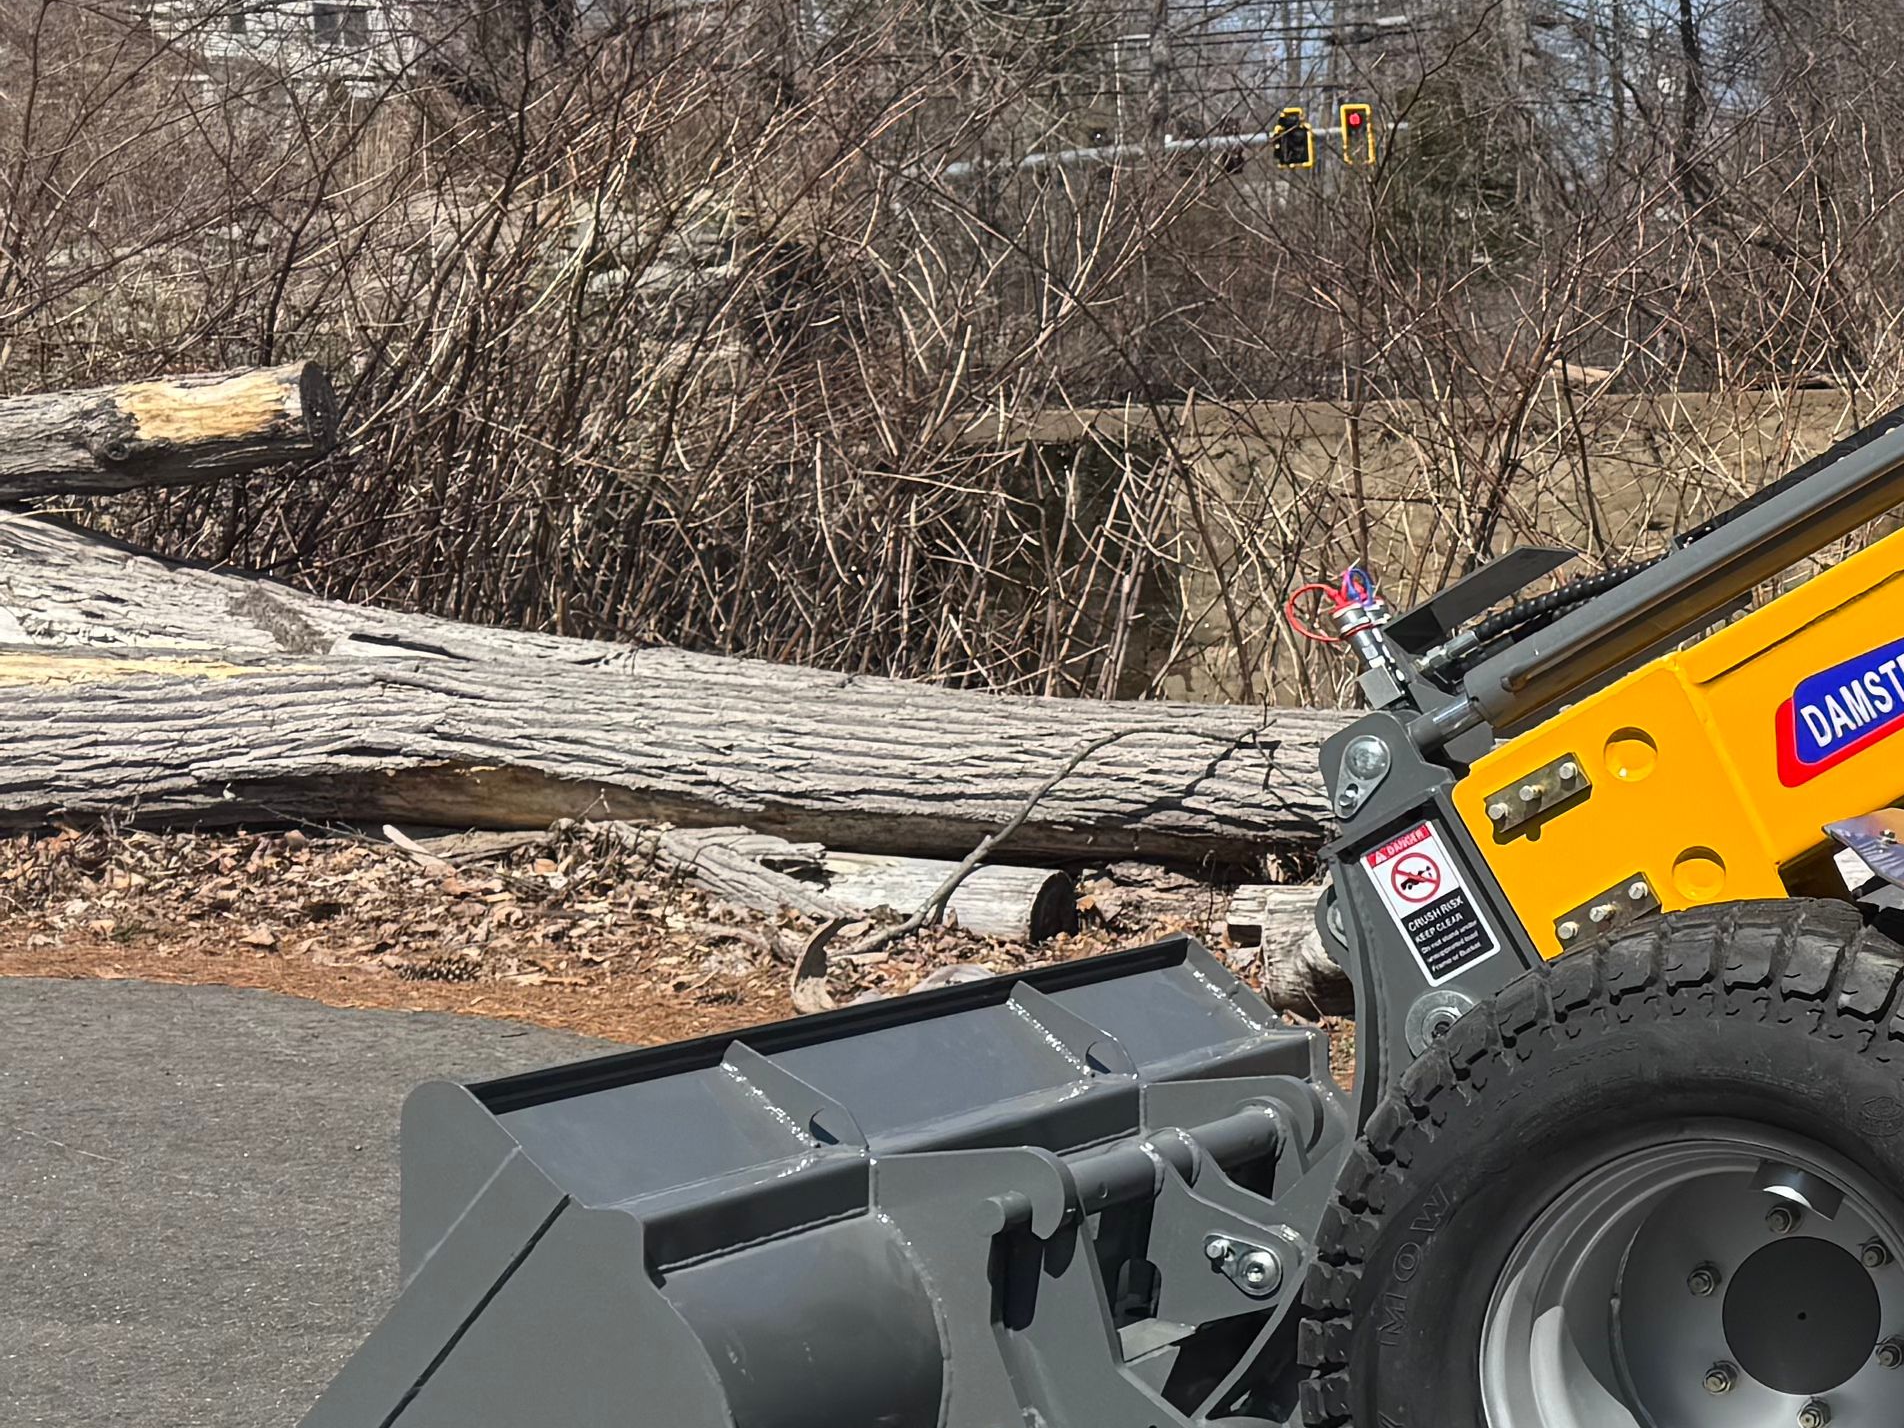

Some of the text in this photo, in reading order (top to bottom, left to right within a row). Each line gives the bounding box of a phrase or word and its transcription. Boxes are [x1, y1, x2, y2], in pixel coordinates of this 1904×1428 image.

[1386, 829, 1425, 856] DANGER
[1408, 895, 1464, 932] CRUSH RISK
[1414, 913, 1464, 944] KEEP CLEAR
[1375, 1177, 1457, 1348] MOW
